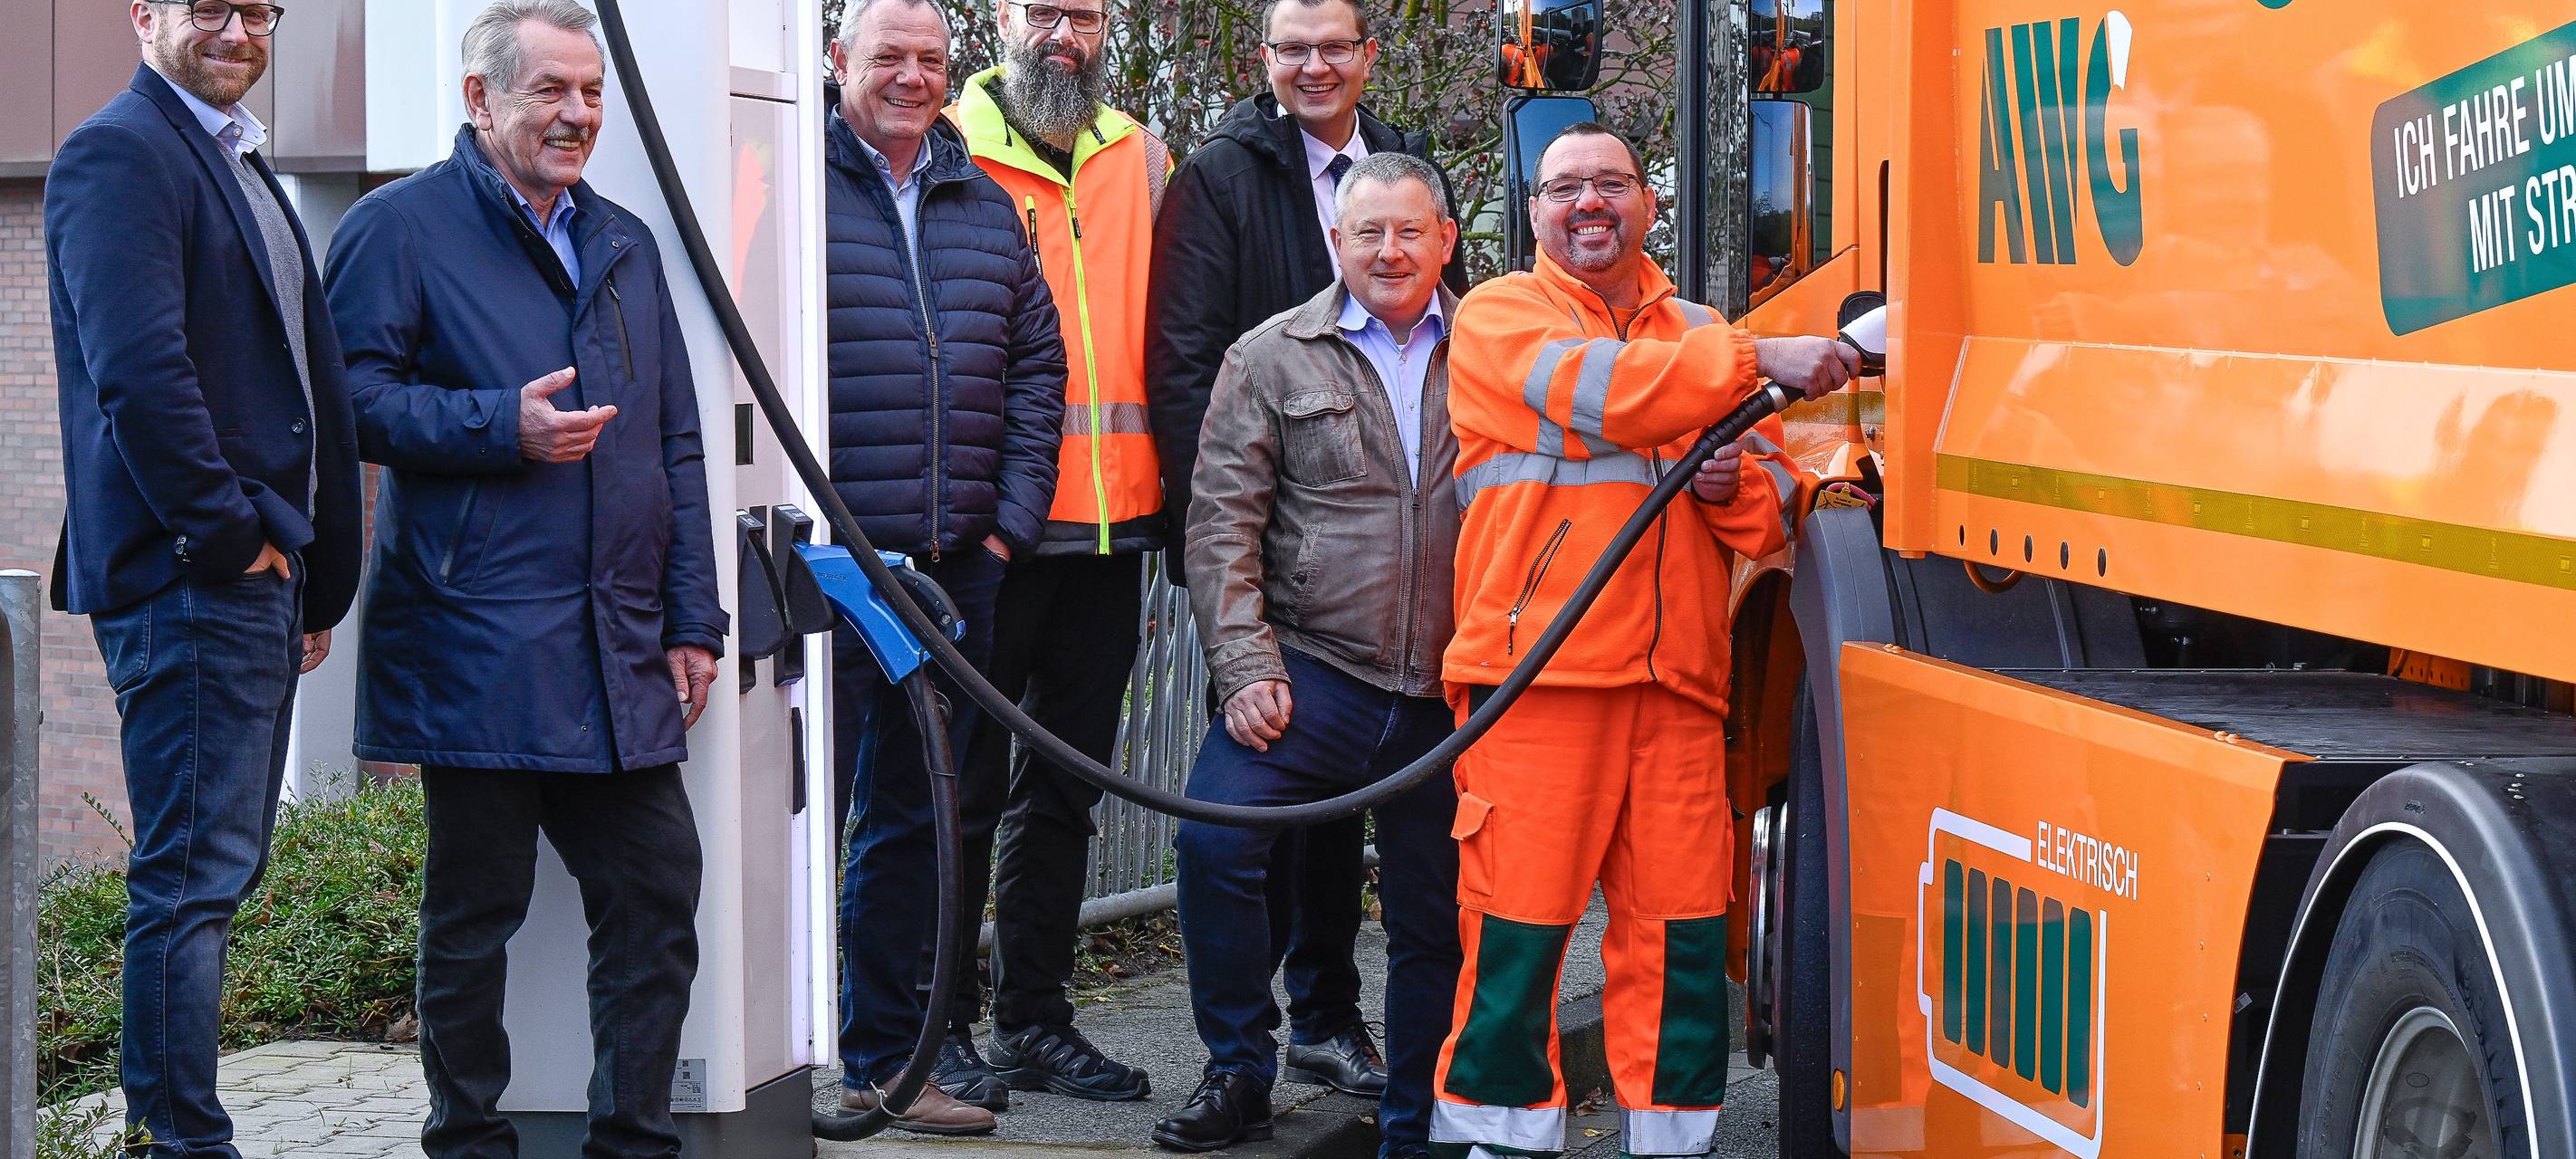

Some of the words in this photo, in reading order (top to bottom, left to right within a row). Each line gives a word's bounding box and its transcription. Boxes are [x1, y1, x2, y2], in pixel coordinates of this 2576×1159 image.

[1978, 10, 2143, 266] AWG
[2394, 114, 2437, 198] ICH
[2443, 76, 2530, 180] FAHRE
[2469, 185, 2515, 273] MIT
[2525, 164, 2576, 255] STR
[2037, 820, 2137, 901] ELEKTRISCH
